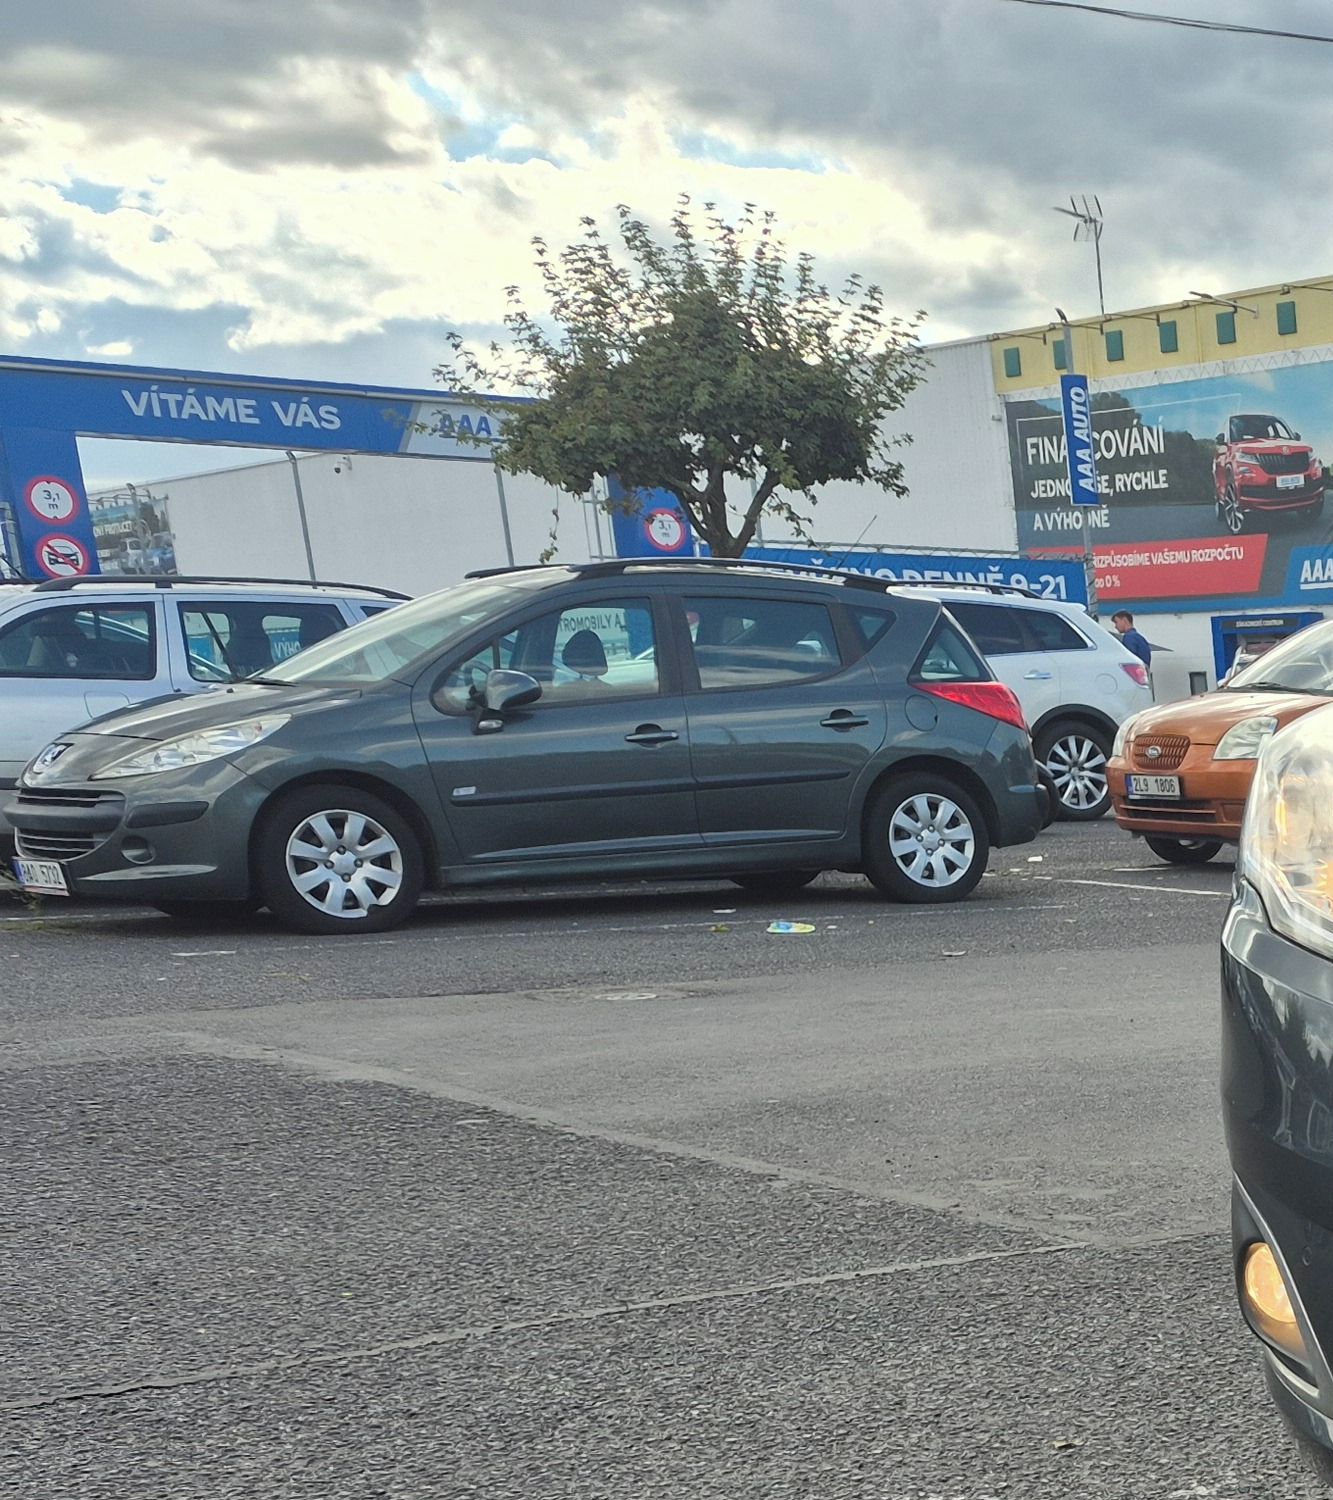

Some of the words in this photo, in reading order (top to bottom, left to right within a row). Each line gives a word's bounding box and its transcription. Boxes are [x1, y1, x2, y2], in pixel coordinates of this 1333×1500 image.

[121, 385, 261, 424] VÍTÁME
[271, 396, 342, 431] VÁS
[1070, 386, 1089, 443] AUTO
[1026, 416, 1165, 465] FINACOVÁNÍ
[1075, 449, 1097, 494] AAA
[1115, 469, 1169, 493] RYCHLE
[1034, 513, 1044, 531] A
[1044, 504, 1110, 531] VÝHONĚ
[1151, 548, 1190, 565] VAŠEMU
[1191, 544, 1244, 562] ROZPOČTU
[1010, 574, 1067, 600] 9-21
[1133, 777, 1149, 792] 2L9
